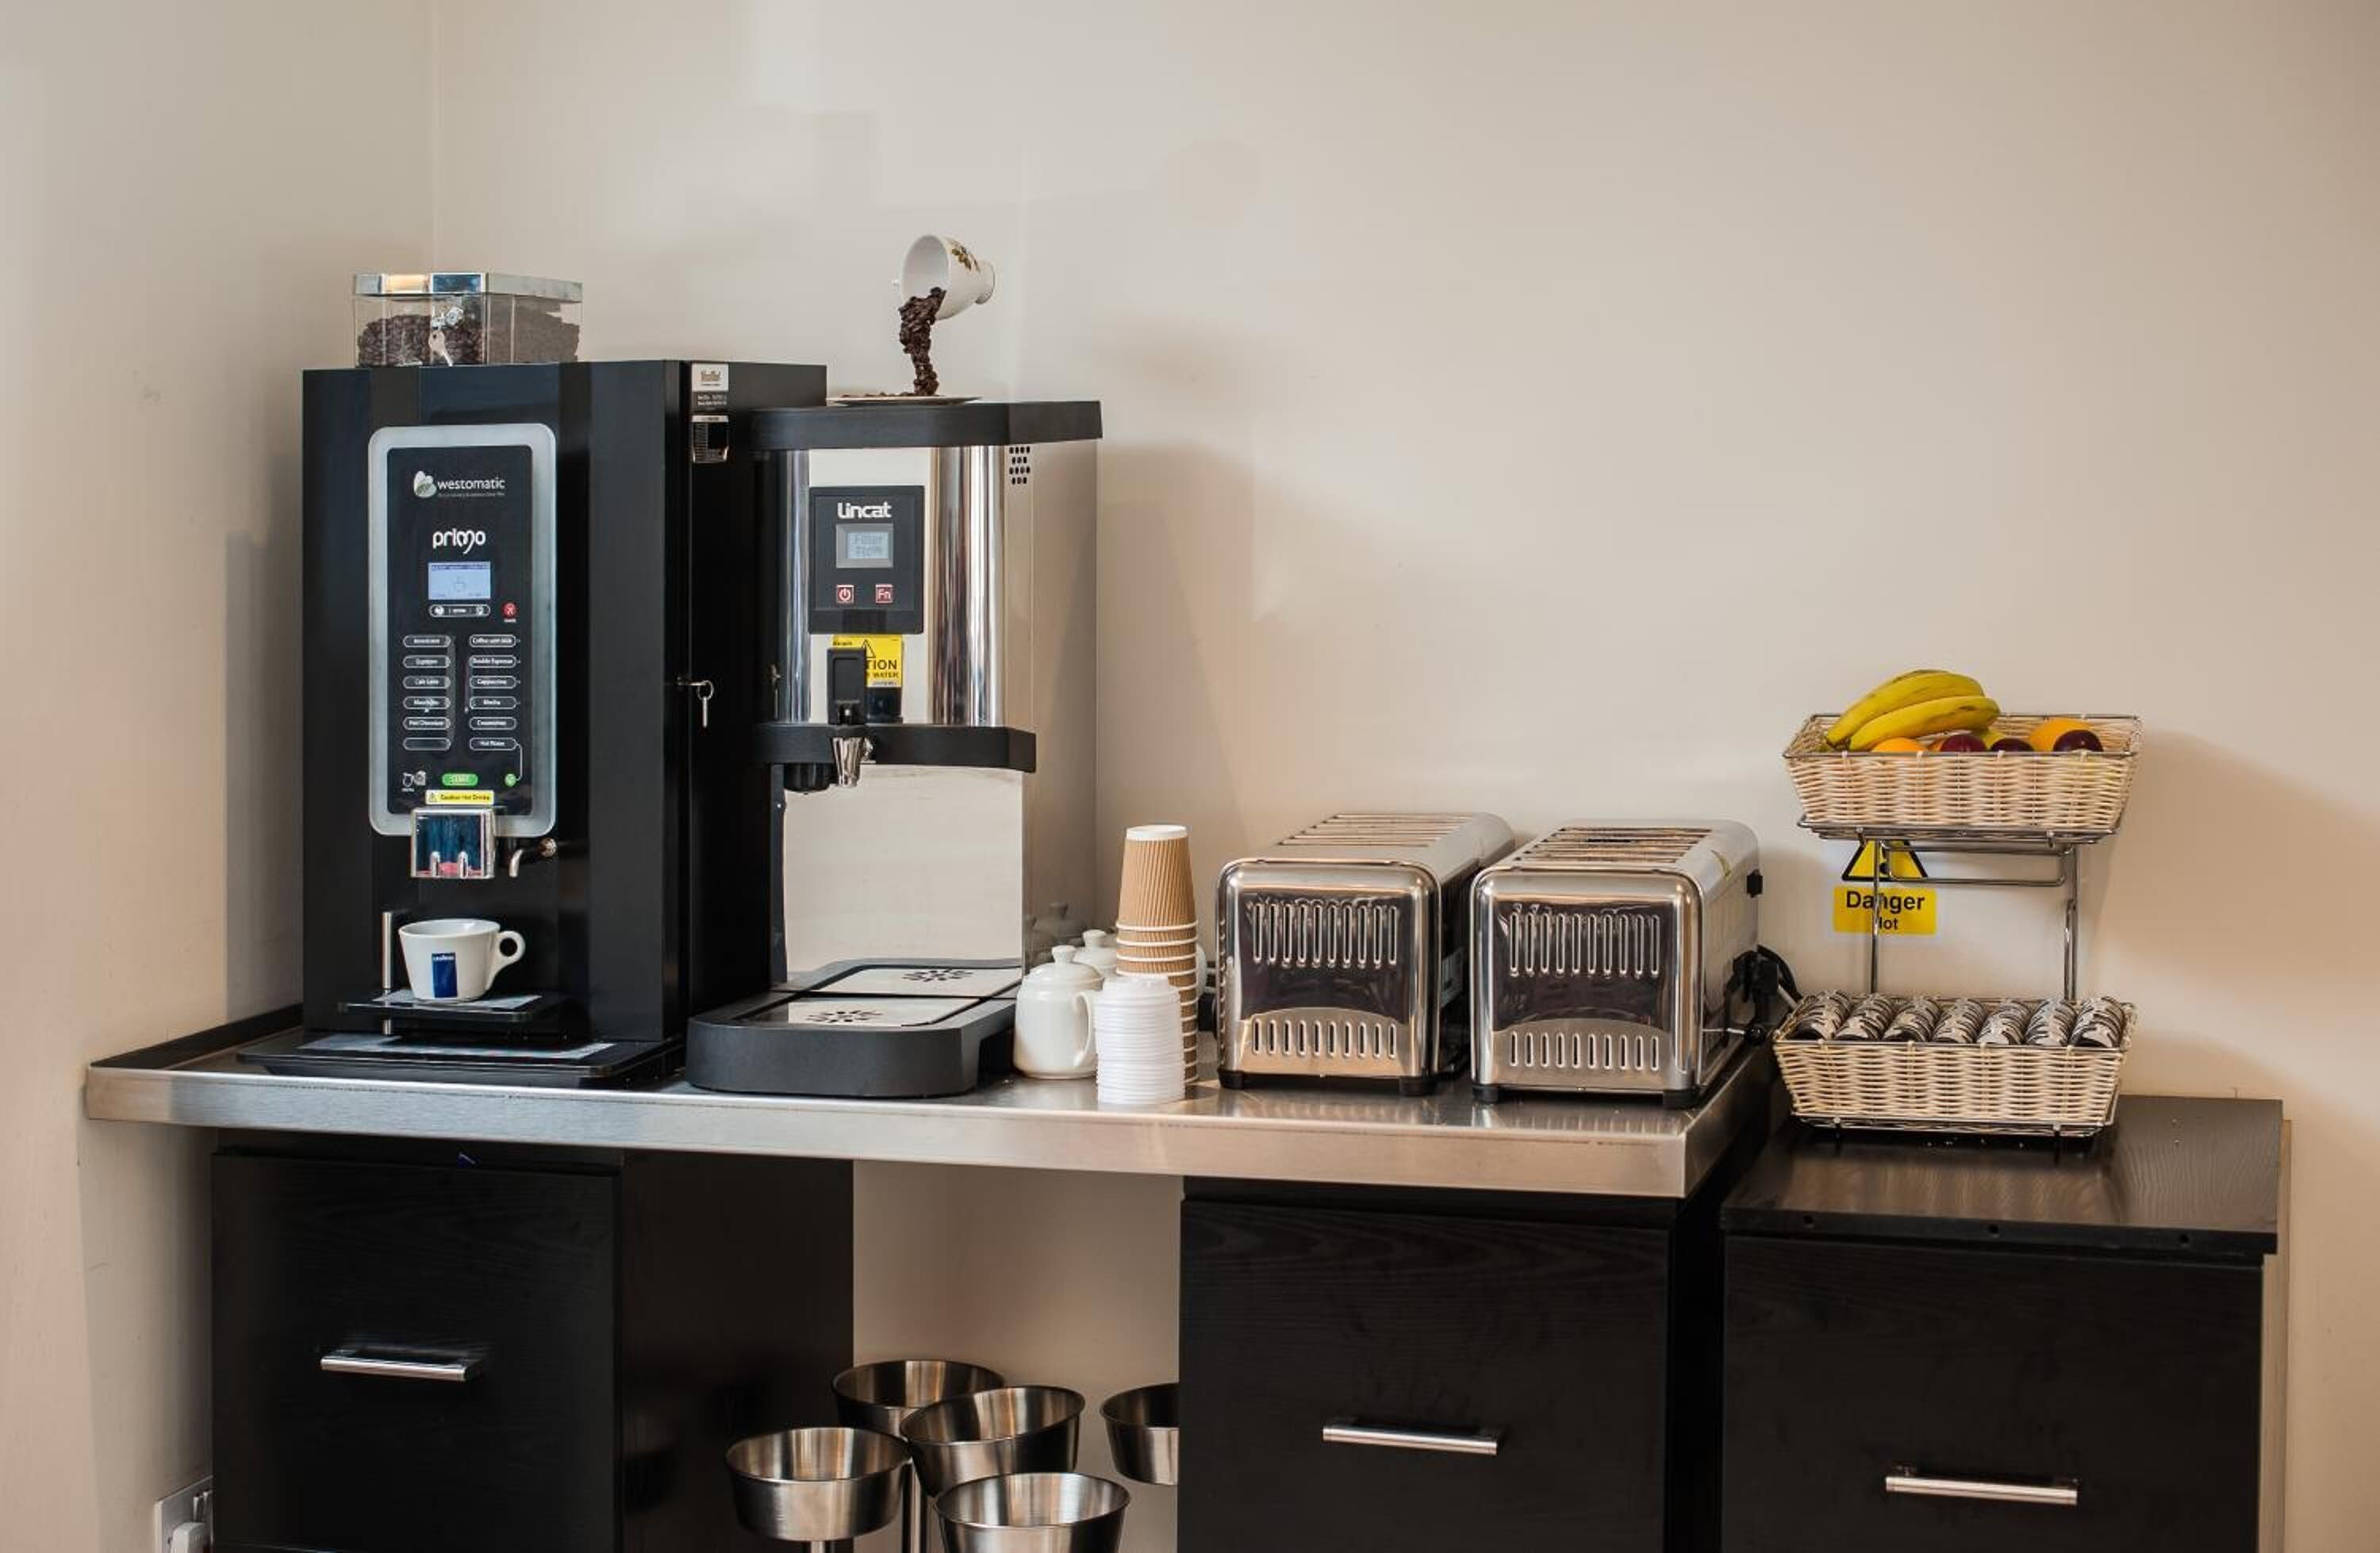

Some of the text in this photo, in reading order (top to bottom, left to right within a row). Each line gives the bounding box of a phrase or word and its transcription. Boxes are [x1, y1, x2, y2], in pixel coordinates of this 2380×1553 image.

[437, 477, 505, 489] westomatic
[432, 528, 486, 554] primo
[877, 589, 891, 600] Fn
[865, 660, 897, 670] TION
[1846, 891, 1925, 914] Danger
